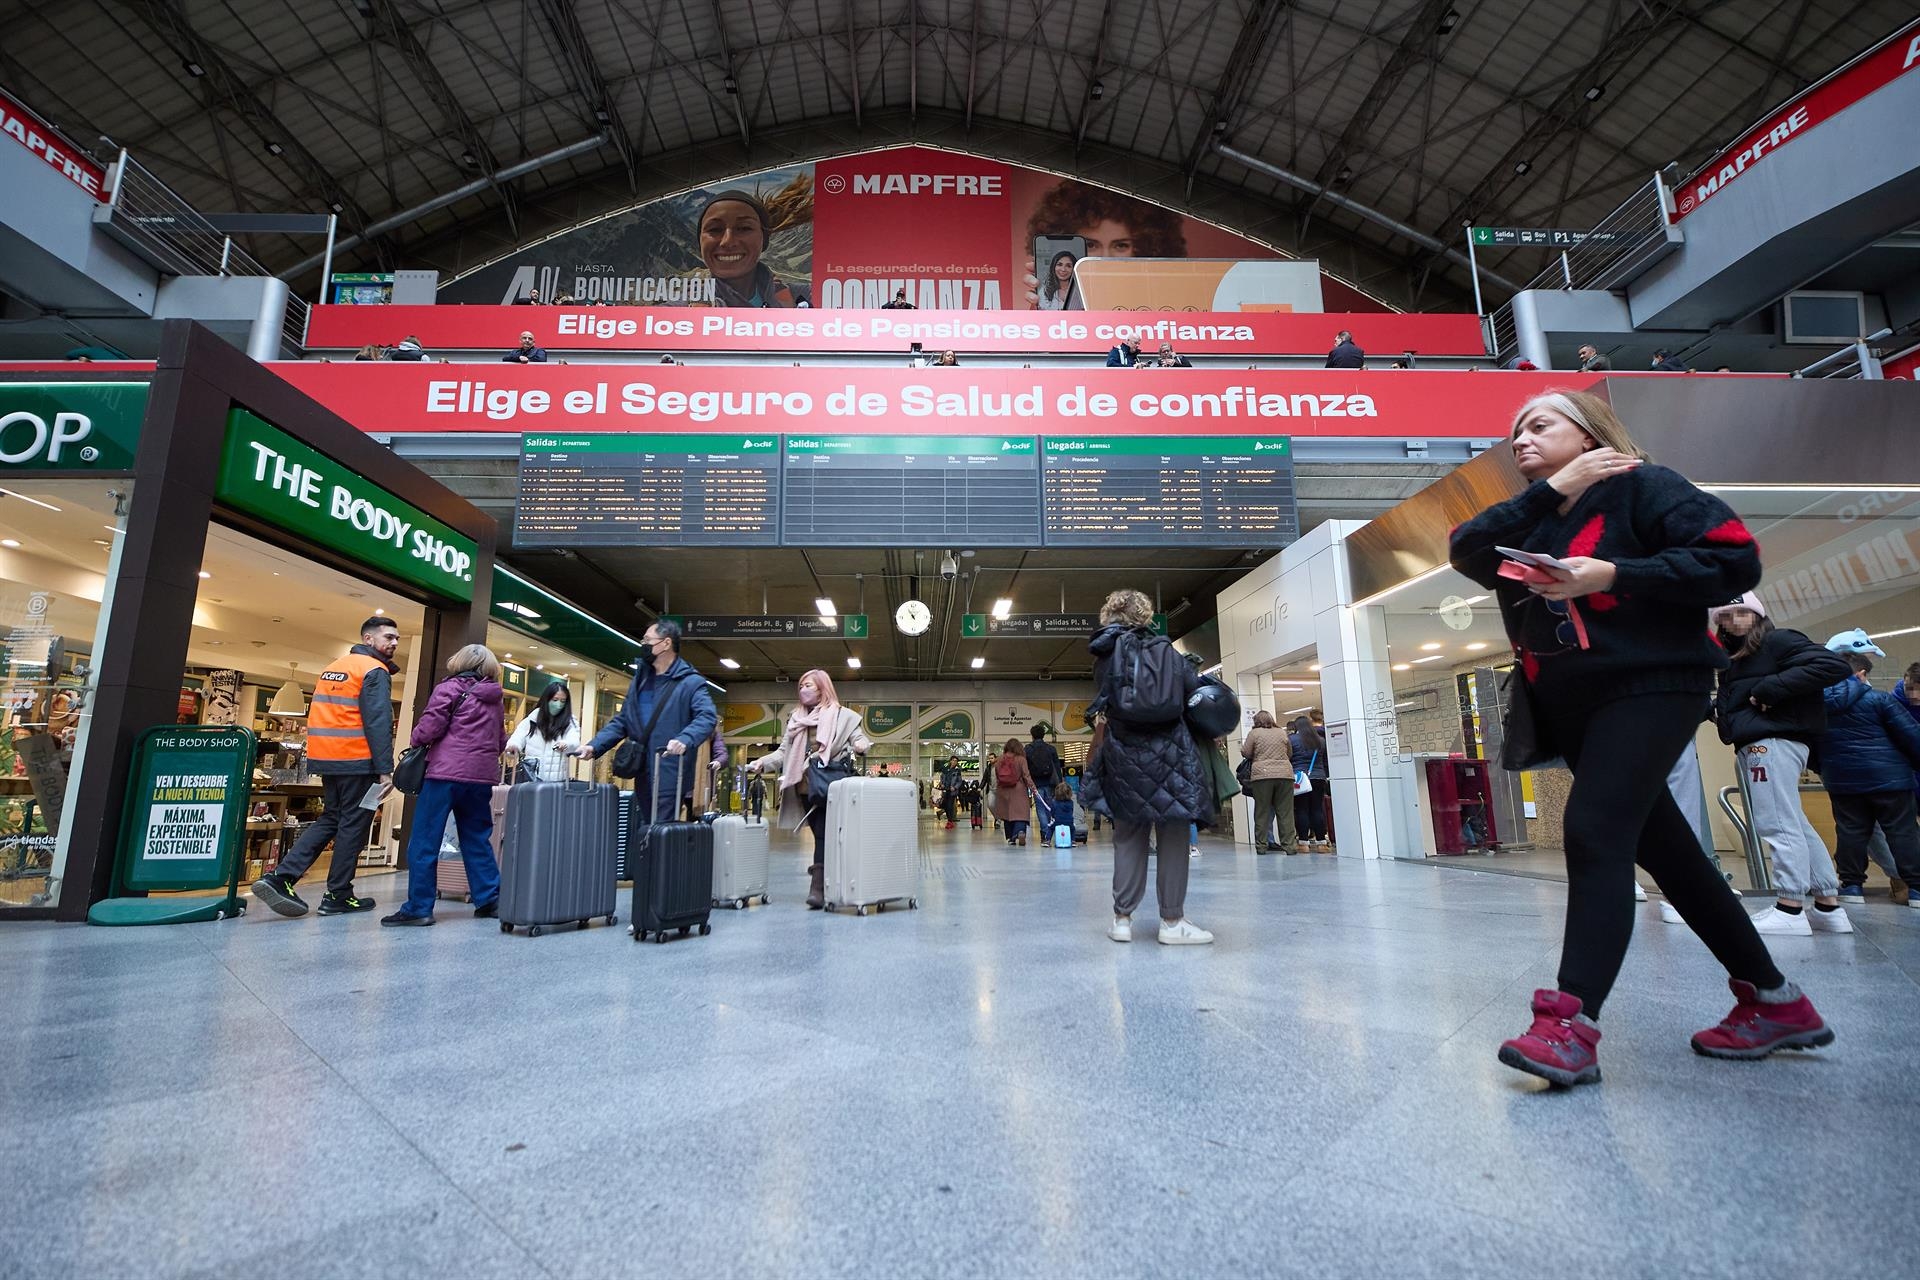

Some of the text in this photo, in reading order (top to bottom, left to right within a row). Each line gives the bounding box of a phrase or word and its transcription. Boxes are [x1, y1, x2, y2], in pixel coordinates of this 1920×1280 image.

[0, 107, 99, 195] APFRE
[1697, 106, 1810, 202] MAPFRE
[853, 174, 1002, 195] MAPFRE
[1554, 232, 1570, 243] P1
[575, 264, 615, 273] HASTA
[826, 263, 998, 275] La aseguradora de más
[574, 273, 716, 302] BONIFICACIÓN
[557, 314, 1255, 341] Elige los Planes de Pensiones de confianza
[426, 380, 1378, 422] Elige el Seguro de Salud de confianza
[526, 438, 558, 447] Salidas
[752, 440, 772, 448] adif
[788, 439, 820, 448] Salidas
[1011, 441, 1031, 449] adif
[1046, 441, 1085, 451] Llegadas
[250, 441, 323, 508] THE
[330, 485, 412, 548] BODY
[1249, 594, 1289, 637] renfe
[1001, 619, 1029, 627] Llegadas
[1045, 619, 1070, 627] Salidas
[156, 738, 175, 747] THE
[179, 738, 208, 747] BODY
[156, 775, 229, 788] VEN Y DESCUBRE
[152, 788, 225, 801] LA NUEVA TIENDA
[163, 806, 205, 824] MÁXIMA
[149, 824, 217, 839] EXPERIENCIA
[21, 835, 58, 846] tiendas
[147, 839, 212, 855] SOSTENIBLE
